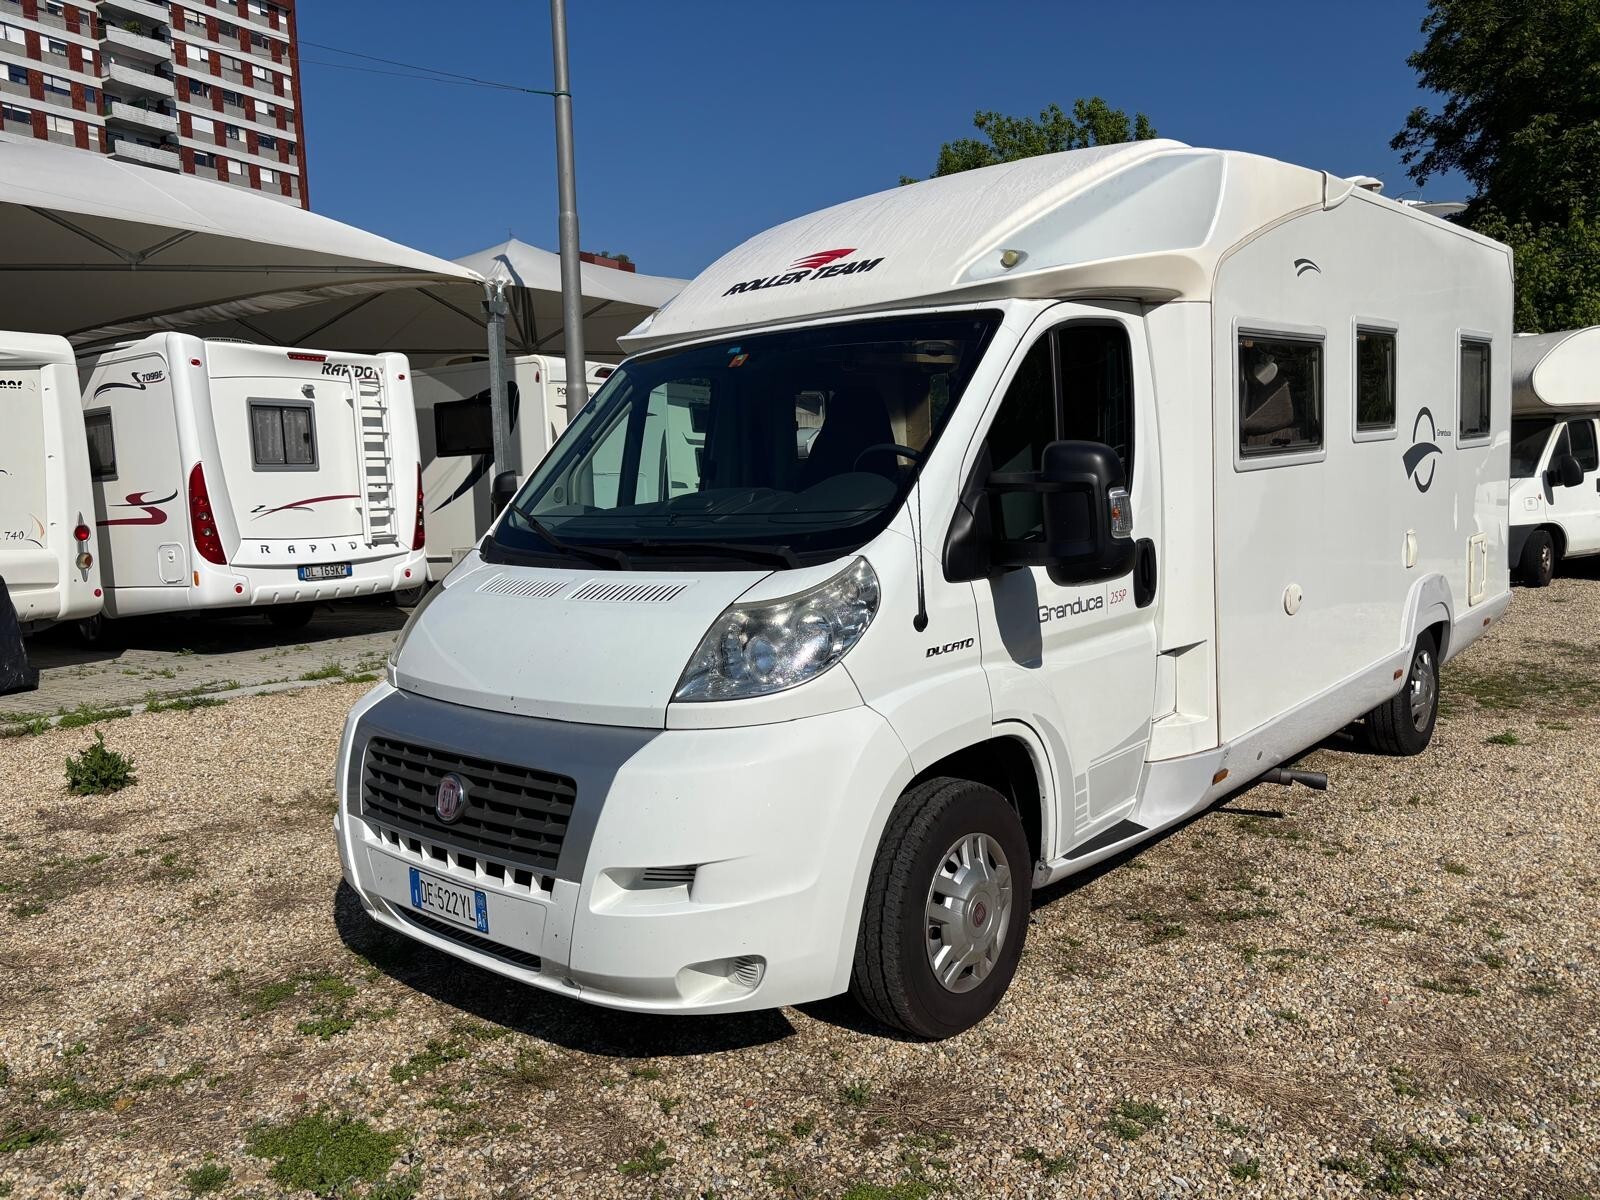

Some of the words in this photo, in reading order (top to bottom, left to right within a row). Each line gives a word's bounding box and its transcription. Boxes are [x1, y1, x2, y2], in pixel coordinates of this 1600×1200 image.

[721, 269, 812, 298] ROLLER
[809, 257, 886, 281] TEAM
[321, 362, 374, 379] RAPDO
[4, 530, 24, 541] 740
[260, 541, 358, 554] RAPID
[1037, 595, 1104, 624] Granduca
[1110, 588, 1127, 605] 255P
[926, 637, 975, 658] DUCATO
[421, 880, 434, 907] DE
[437, 886, 476, 922] 522YL
